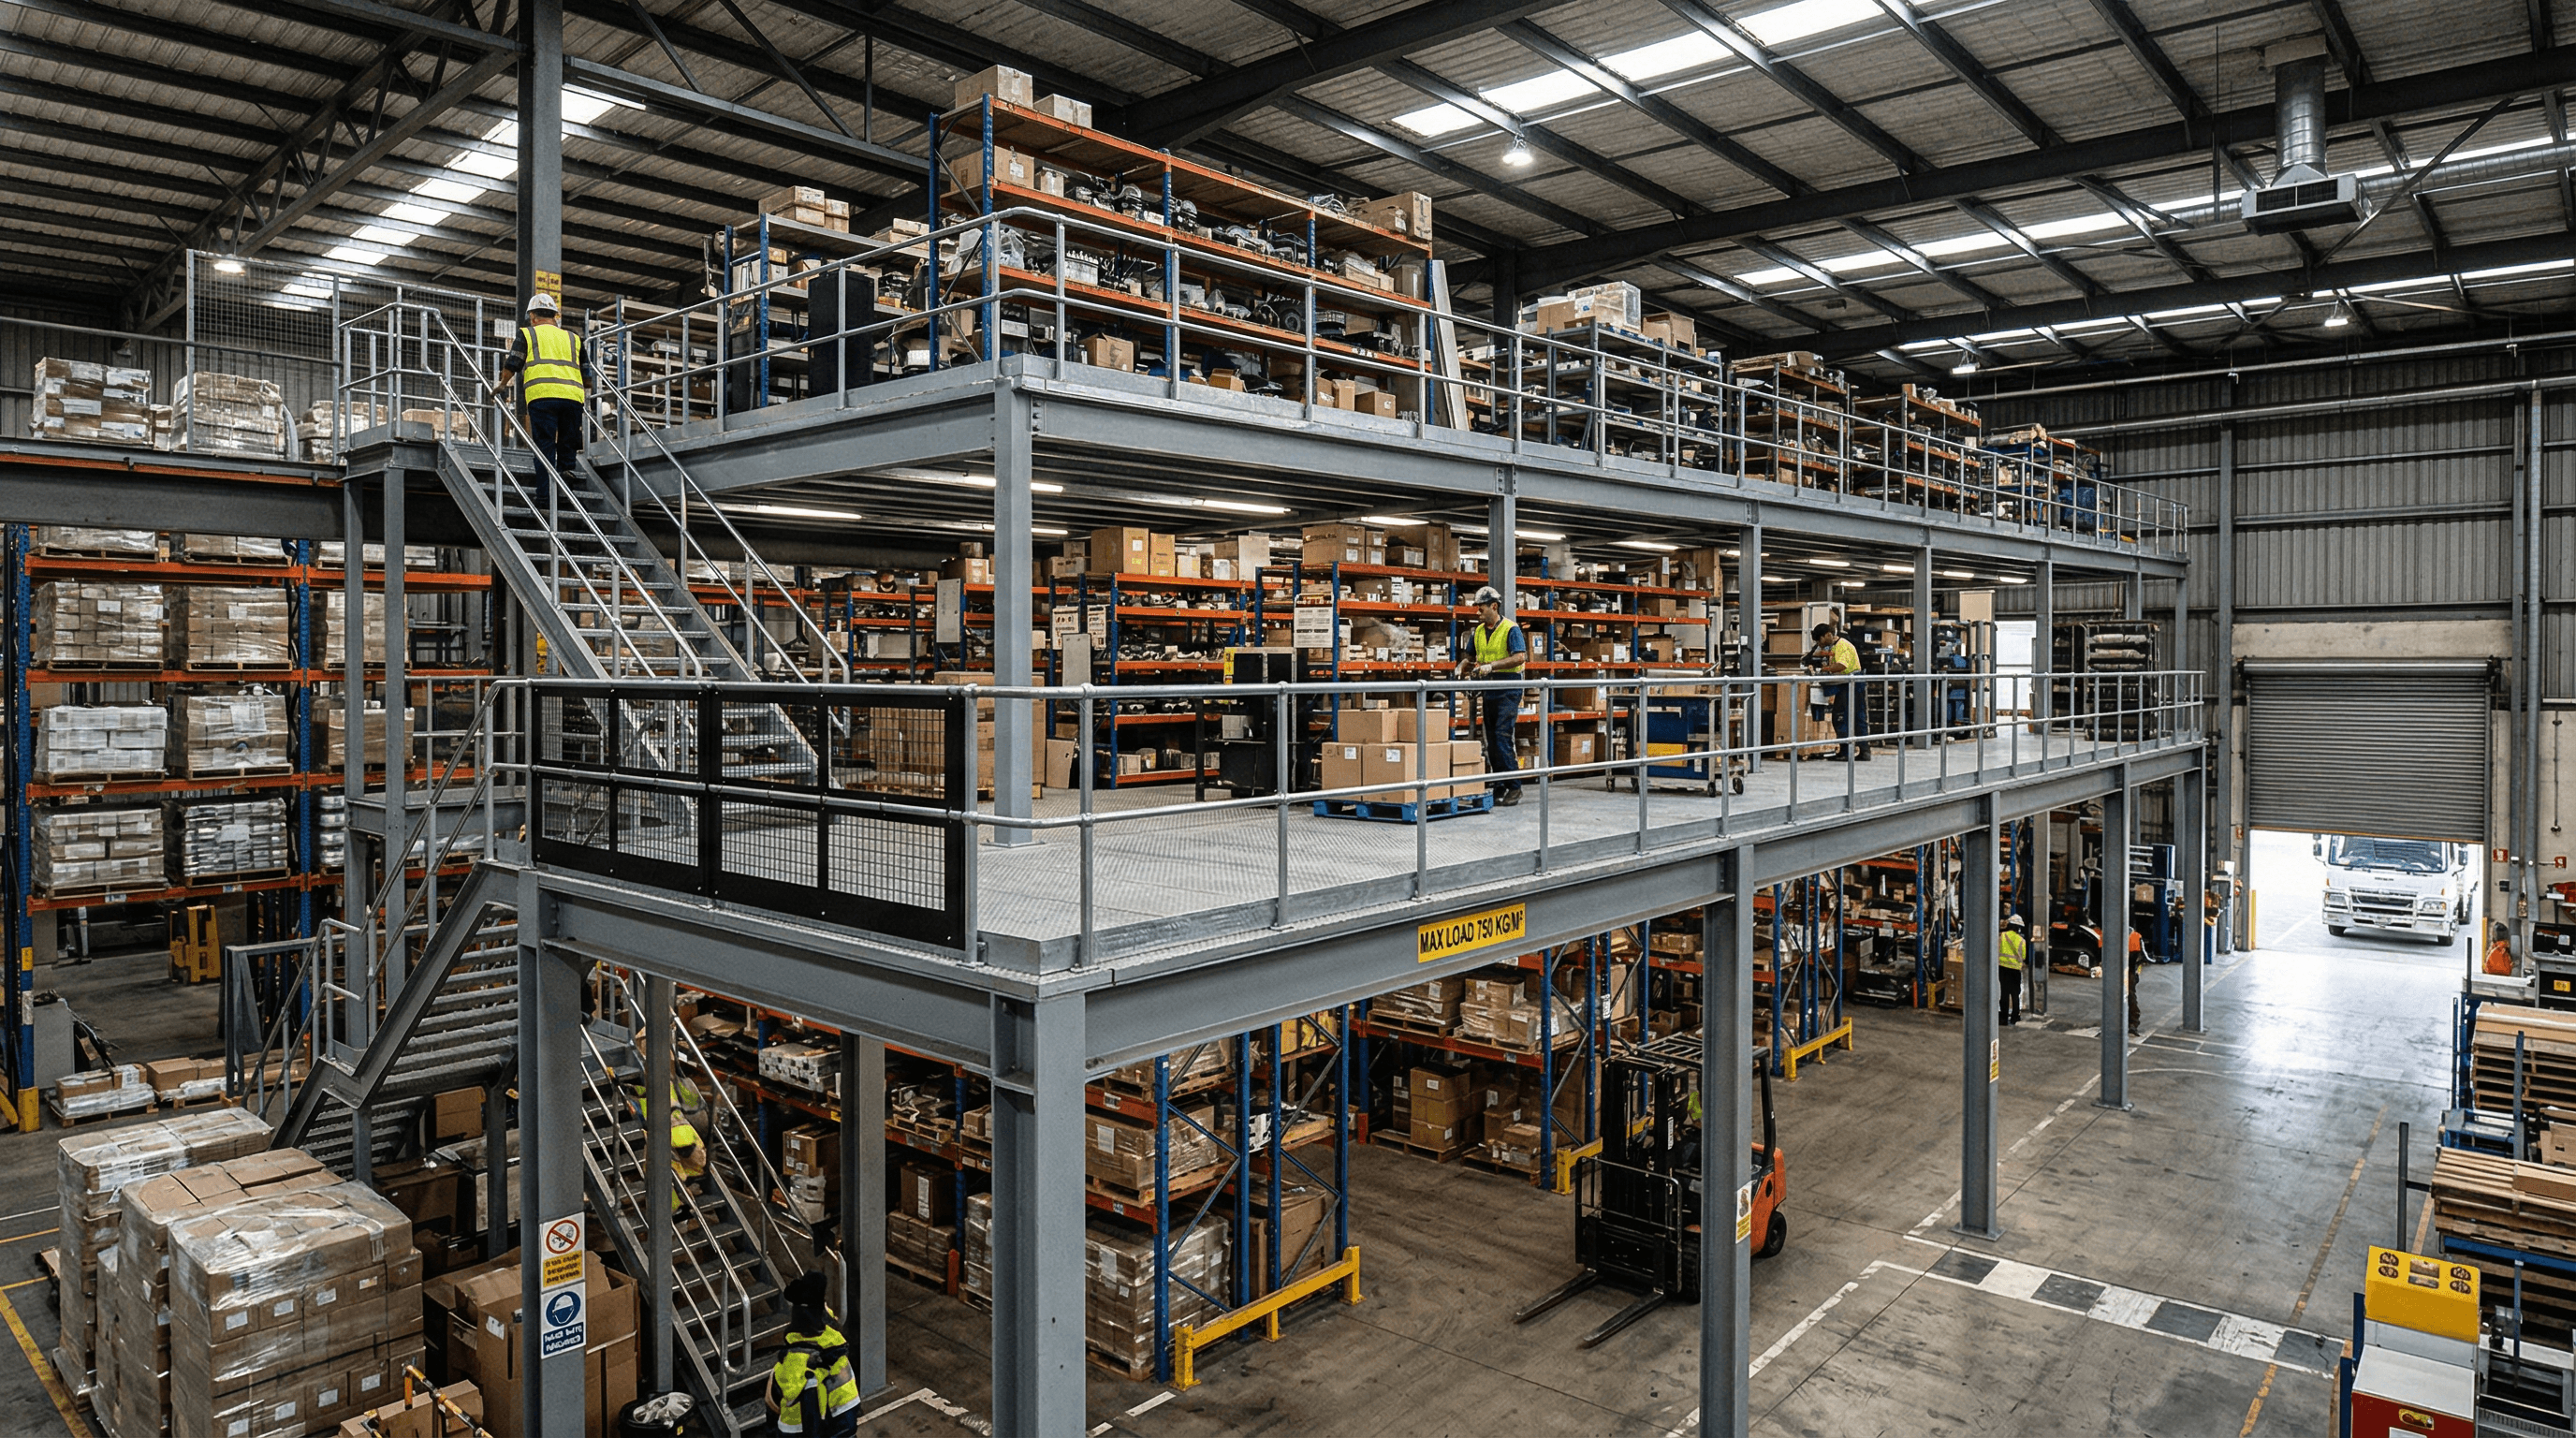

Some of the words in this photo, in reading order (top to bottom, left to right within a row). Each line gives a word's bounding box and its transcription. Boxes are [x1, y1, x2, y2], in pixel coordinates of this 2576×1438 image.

[1420, 928, 1444, 954] MAX
[1446, 922, 1474, 947] LOAD
[1477, 917, 1493, 940] 750
